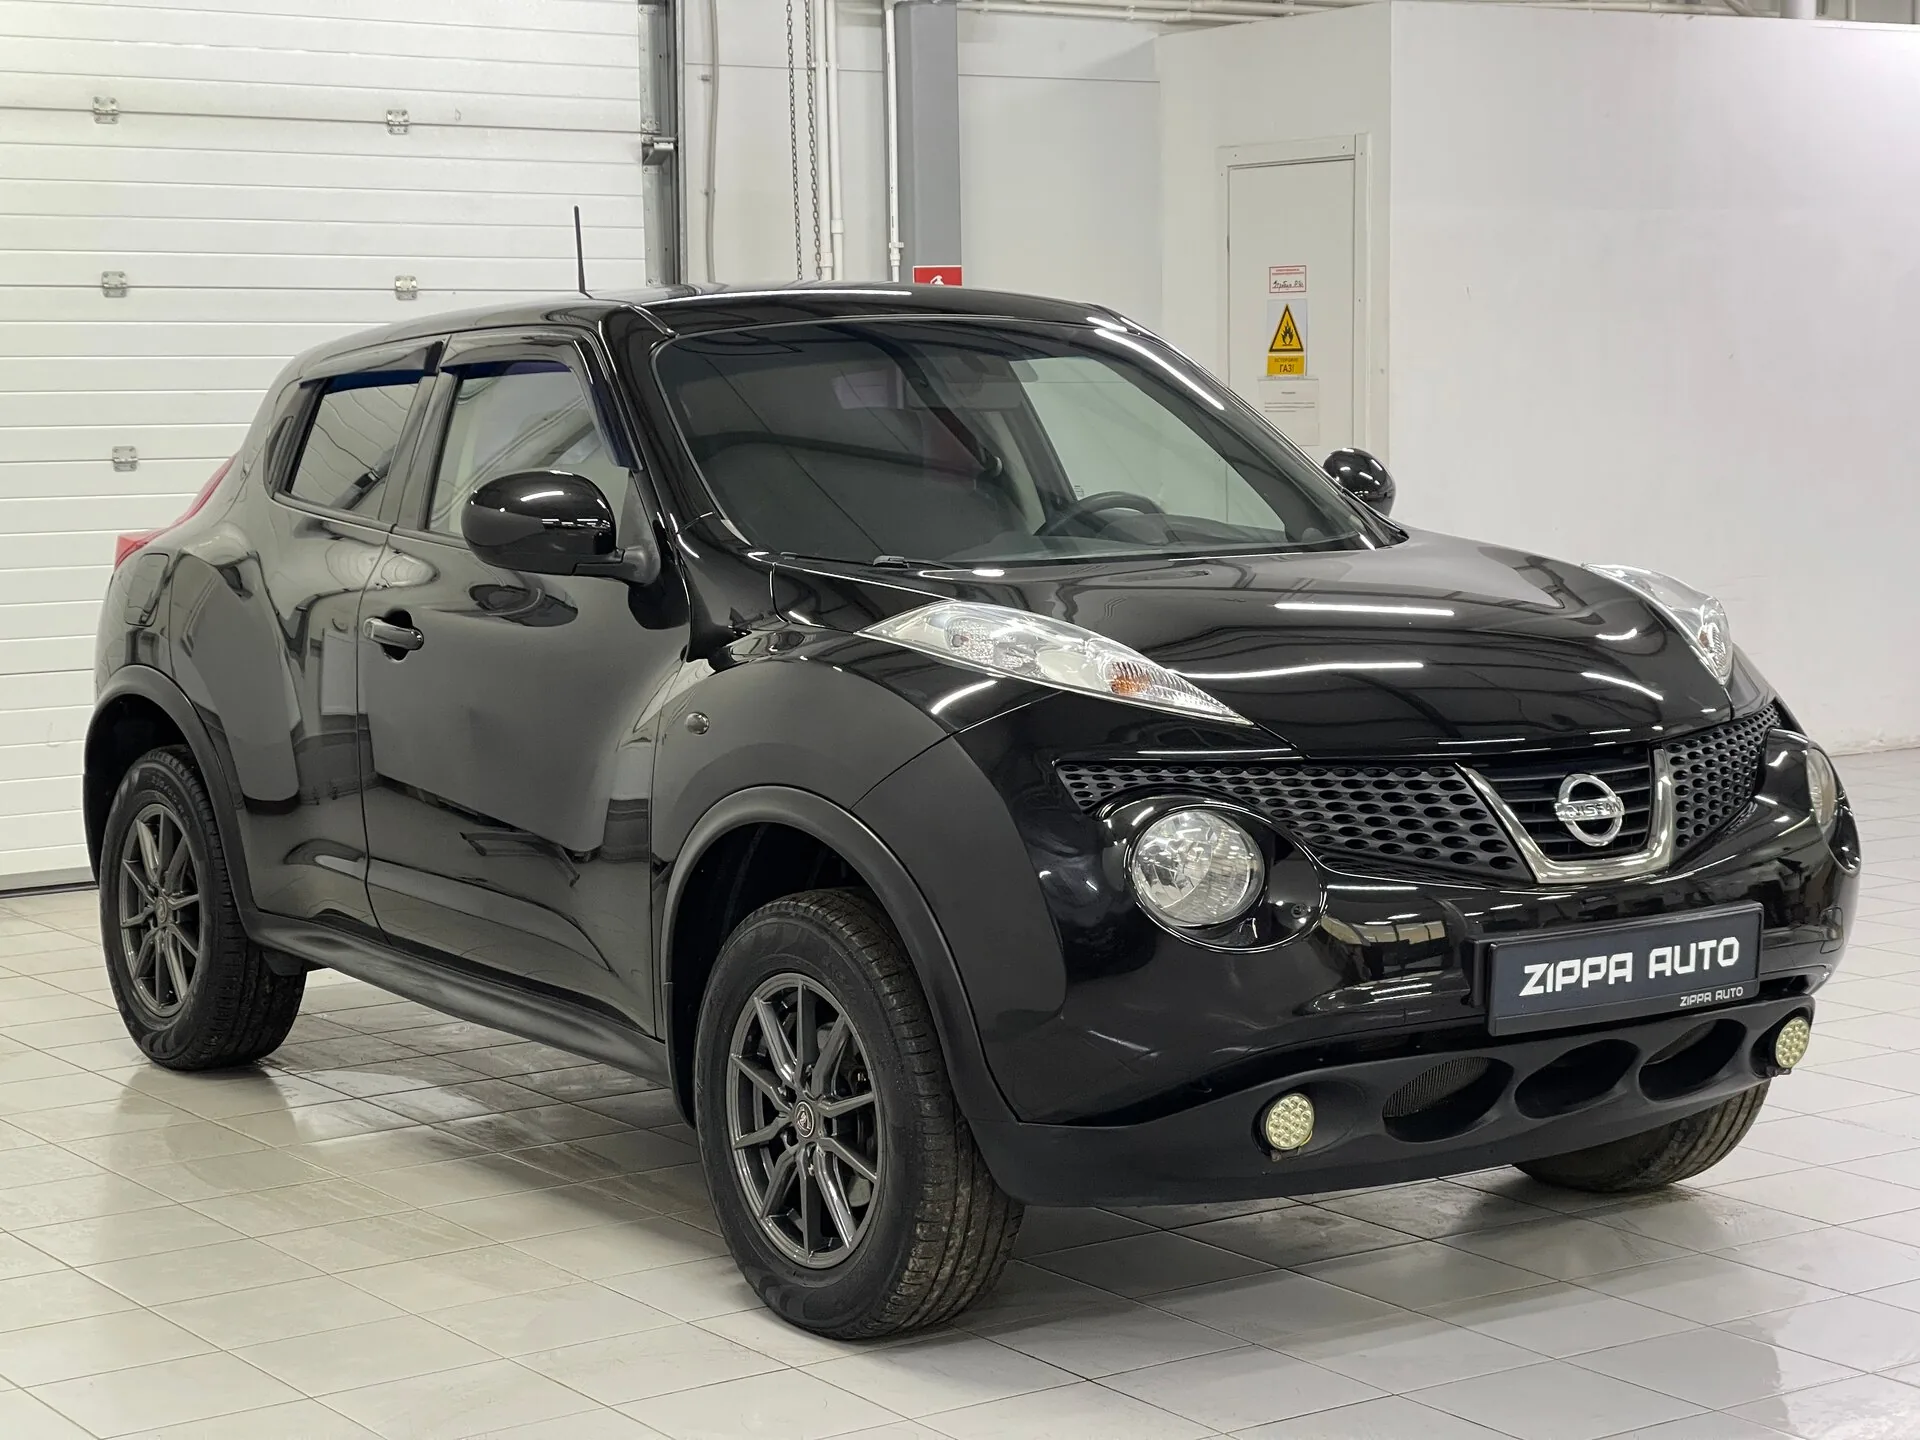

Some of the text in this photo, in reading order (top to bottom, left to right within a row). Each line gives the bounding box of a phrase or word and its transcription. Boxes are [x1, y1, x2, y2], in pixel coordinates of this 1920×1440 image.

[1519, 936, 1740, 997] ZIPPA AUTO
[1679, 986, 1744, 1007] ZIPPA AUTO
